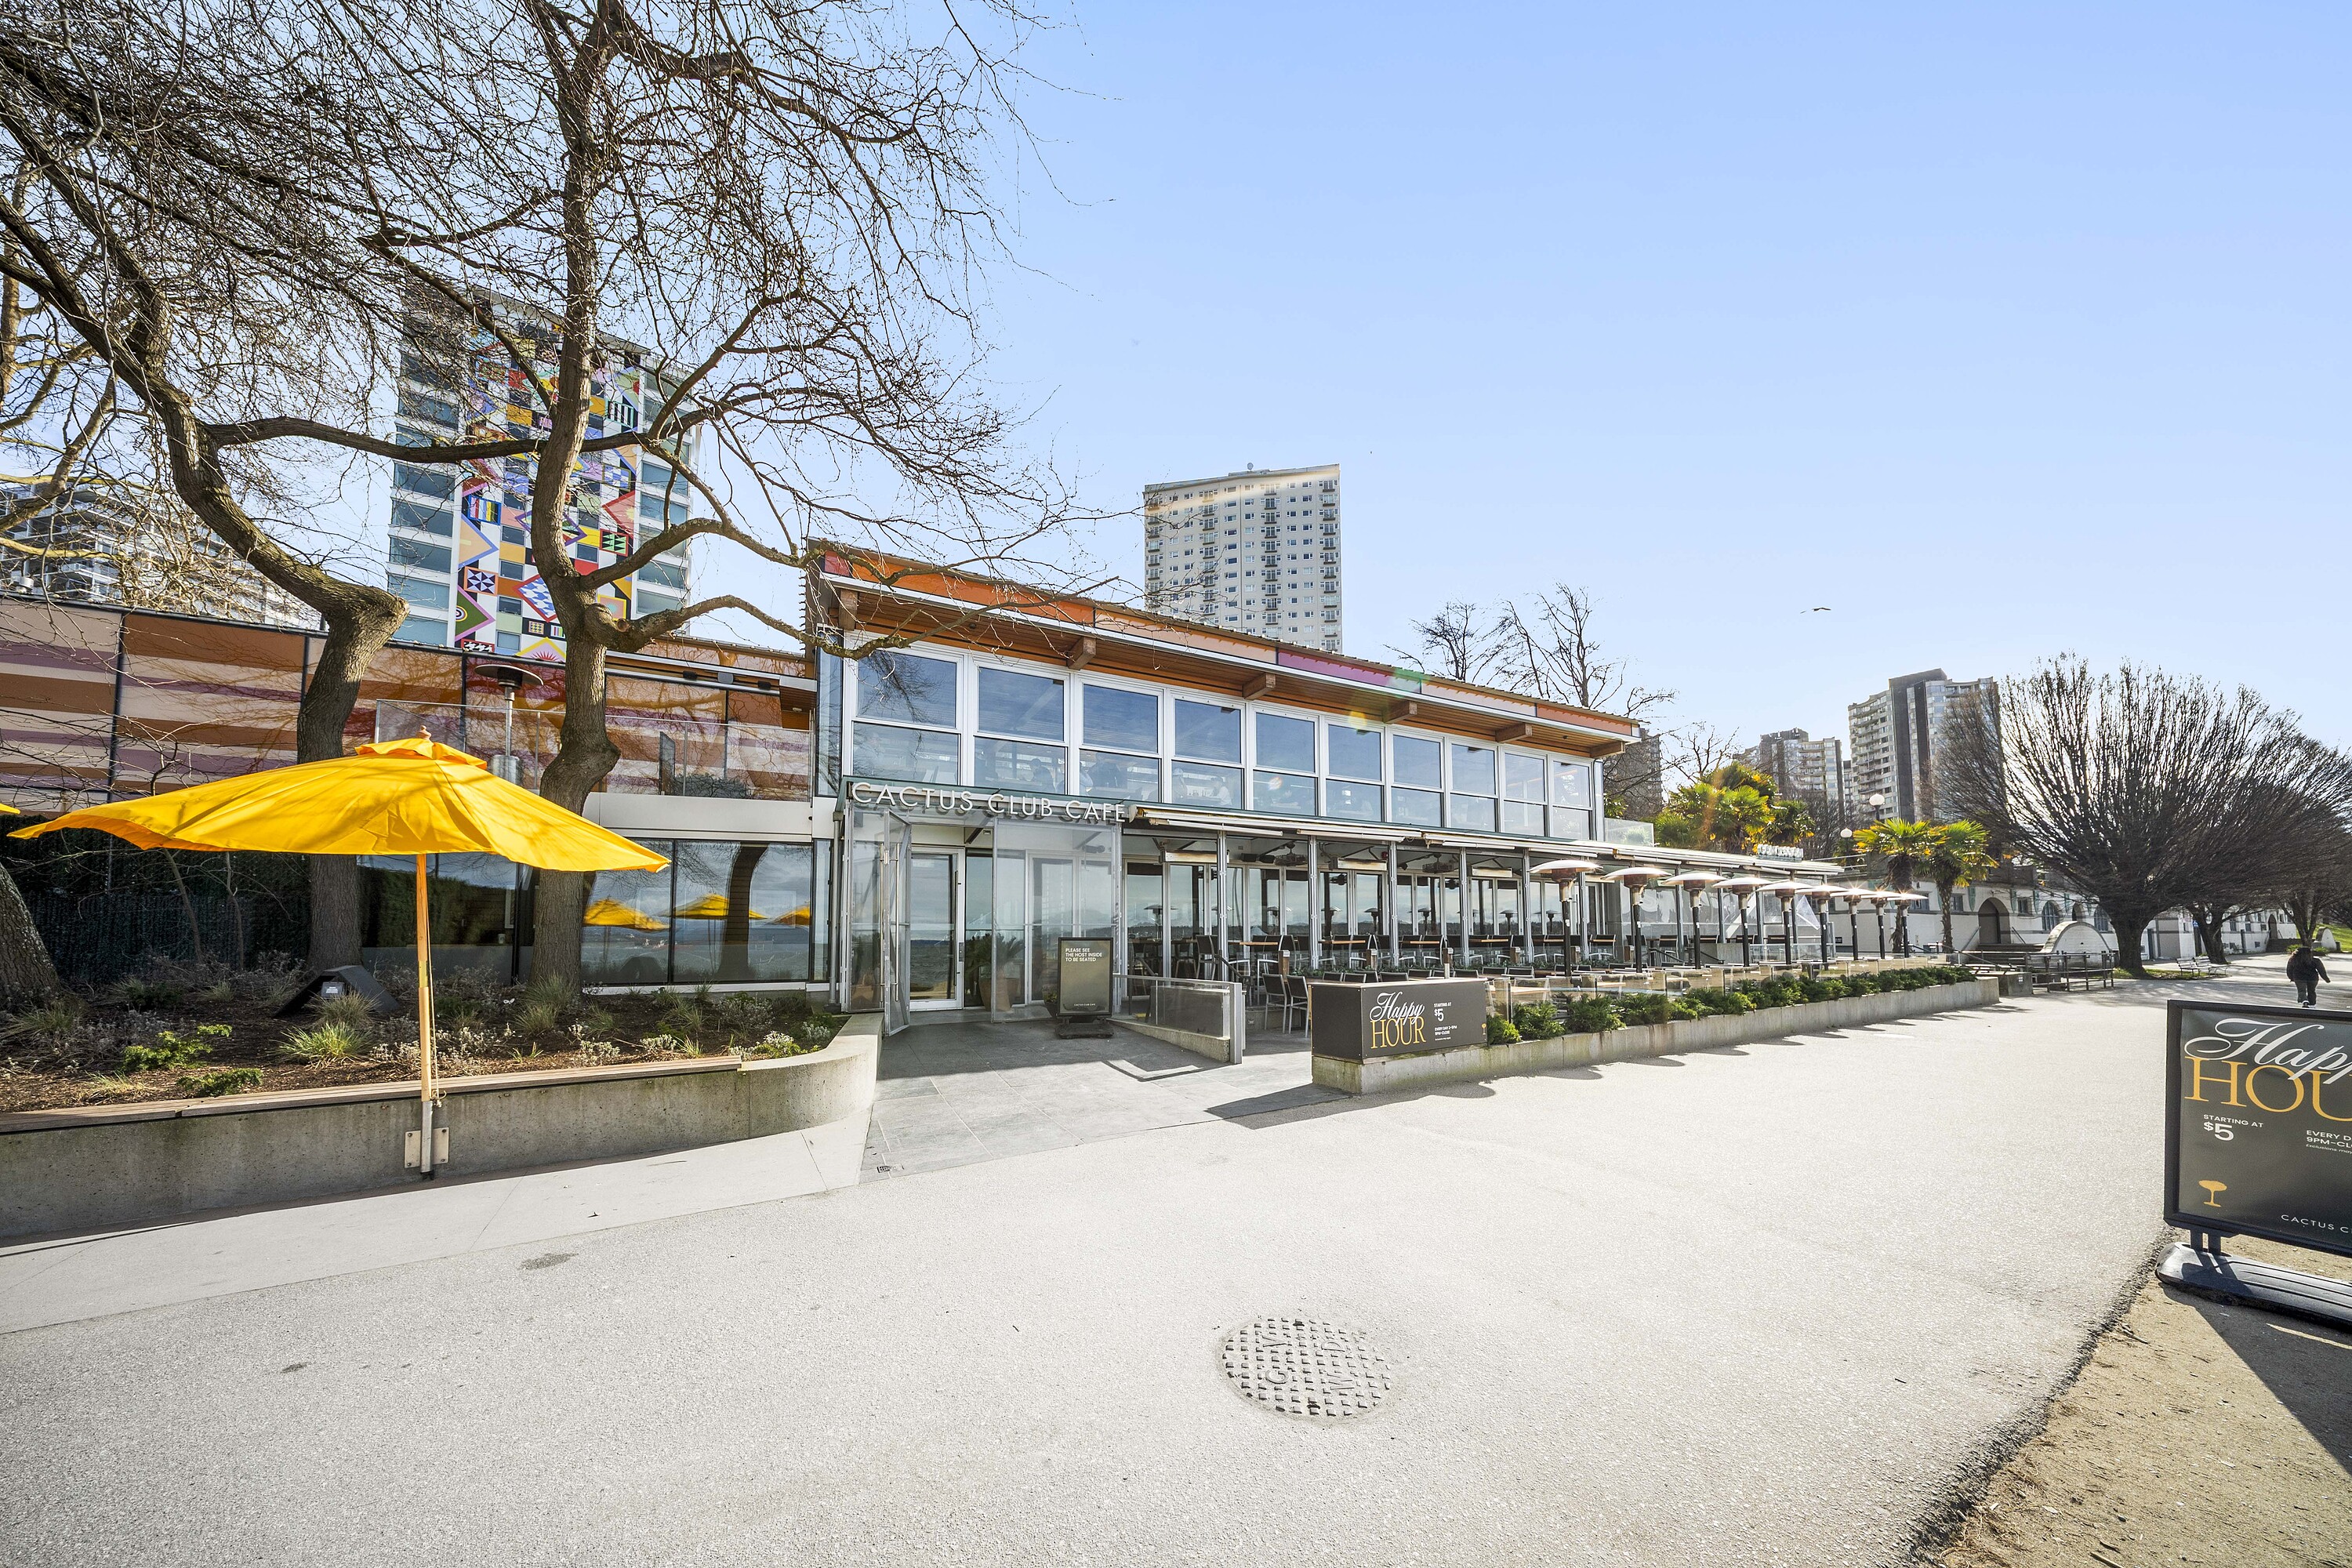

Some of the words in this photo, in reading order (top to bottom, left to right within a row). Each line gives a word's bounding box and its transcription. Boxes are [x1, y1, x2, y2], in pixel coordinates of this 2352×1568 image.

[851, 782, 973, 812] CACTUS
[988, 793, 1053, 818] CLUB
[1065, 800, 1126, 822] CAFE
[1370, 991, 1425, 1026] Happy
[1434, 1008, 1444, 1022] $5
[1370, 1016, 1426, 1049] HOUR
[2203, 1114, 2249, 1126] STARTING
[2203, 1121, 2234, 1142] $5
[2307, 1130, 2340, 1139] EVERY
[2306, 1143, 2337, 1152] Exclusions
[2307, 1137, 2352, 1149] 9PM-CL
[2281, 1214, 2335, 1230] CACTUS
